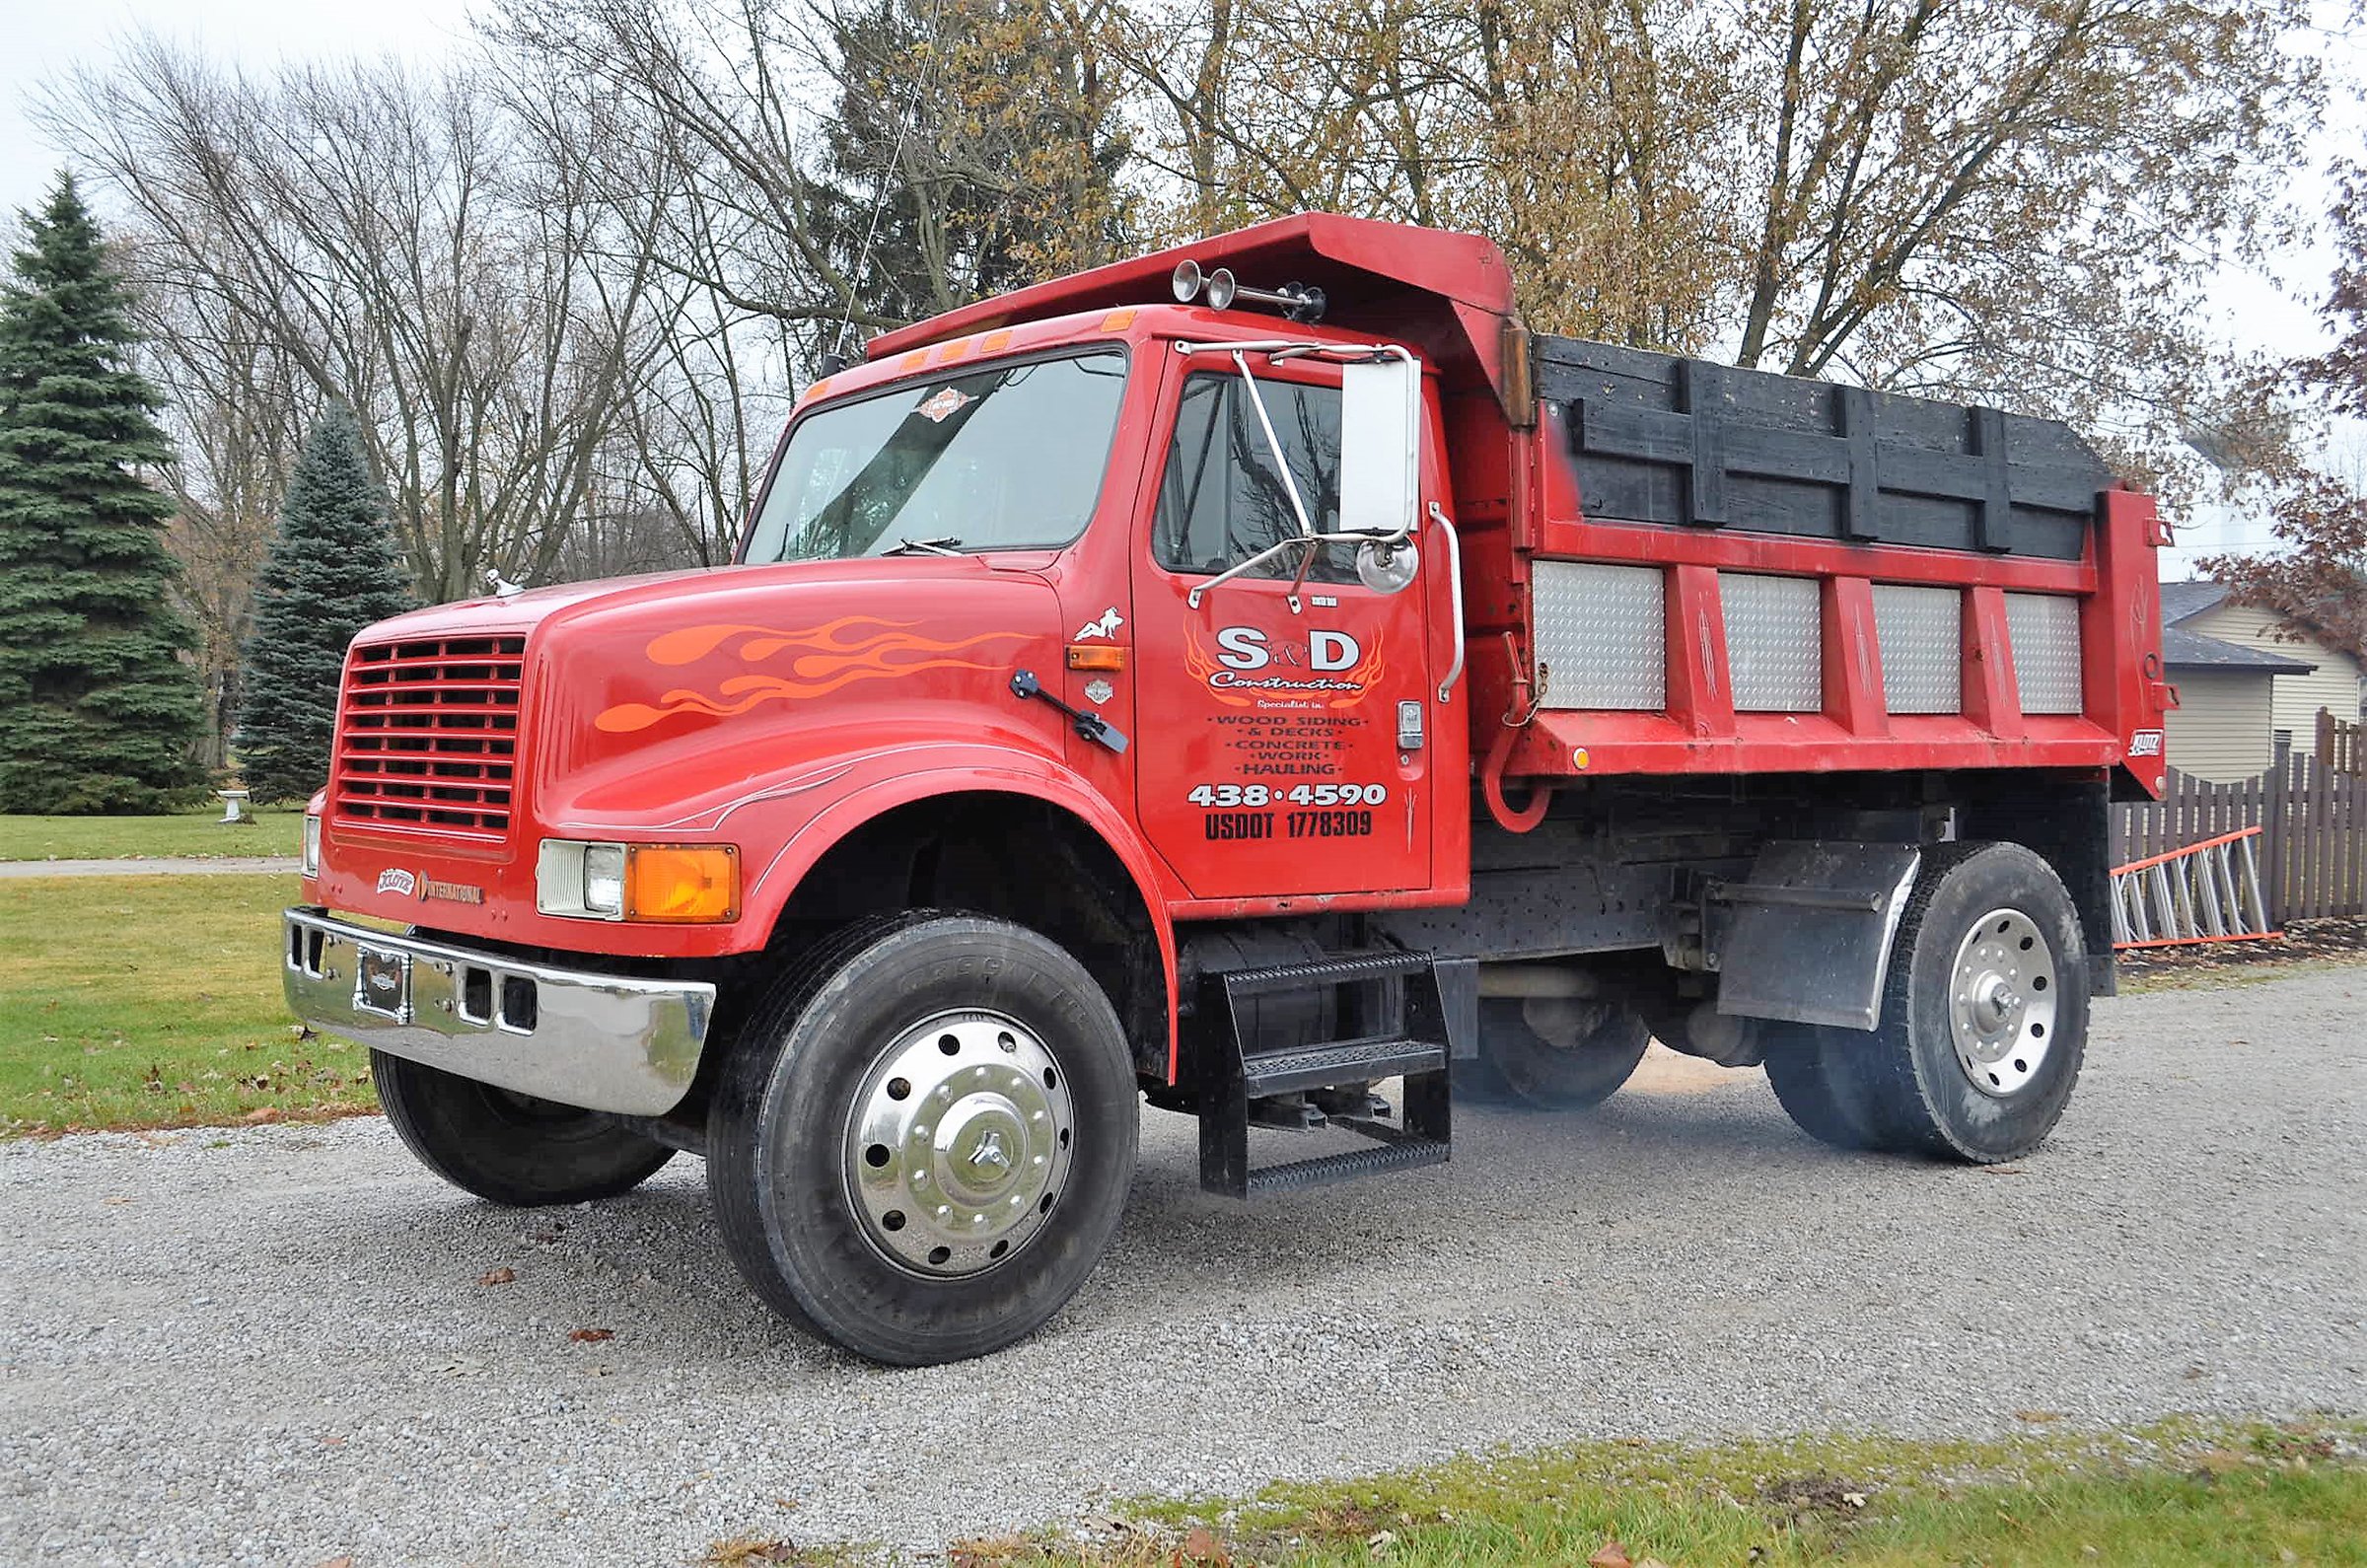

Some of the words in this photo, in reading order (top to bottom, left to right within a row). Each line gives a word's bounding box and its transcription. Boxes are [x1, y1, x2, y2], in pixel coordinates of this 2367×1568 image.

[1216, 626, 1270, 671] S
[1309, 629, 1360, 672] D
[1208, 671, 1364, 690] Construction
[1256, 699, 1309, 709] Specialist
[1217, 715, 1288, 725] WOOD
[1296, 717, 1361, 727] SIDING
[1270, 728, 1334, 737] DECKS
[1235, 741, 1346, 749] CONCRETE
[1257, 751, 1322, 760] WORK
[1243, 764, 1335, 775] HAULING
[1205, 813, 1274, 839] USDOT
[1287, 811, 1372, 838] 1778309
[427, 880, 482, 903] INTERNATIONAL
